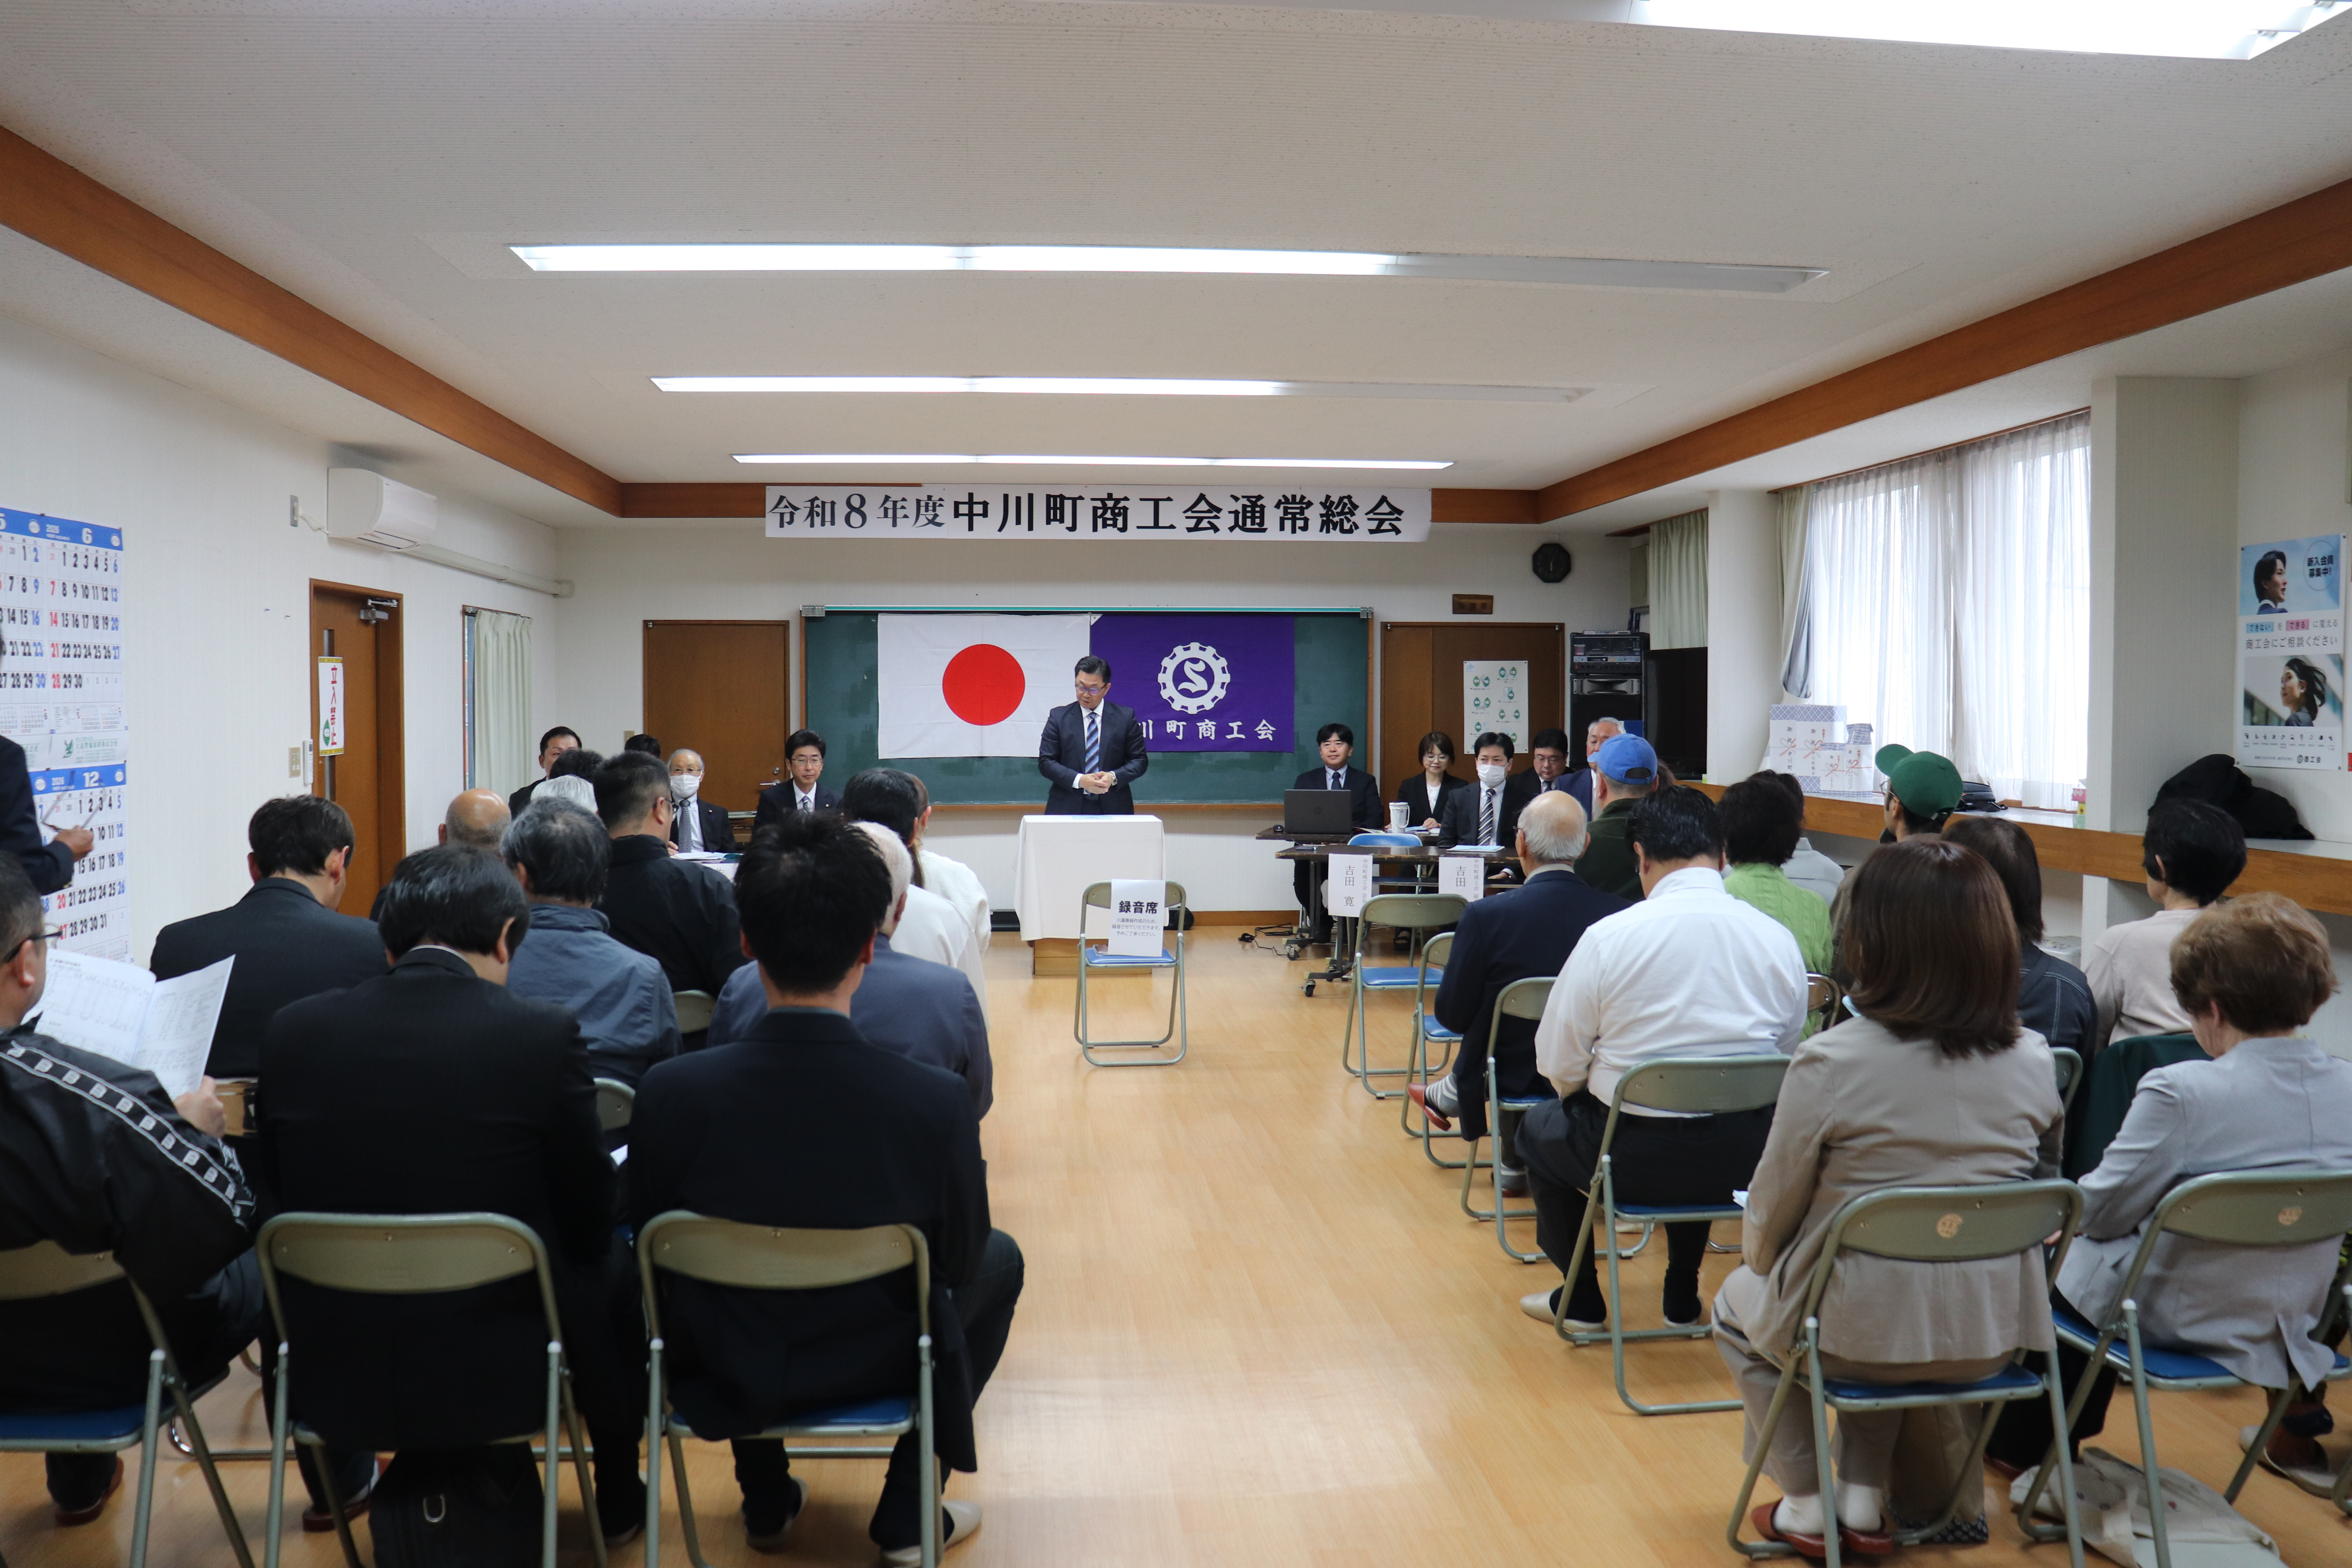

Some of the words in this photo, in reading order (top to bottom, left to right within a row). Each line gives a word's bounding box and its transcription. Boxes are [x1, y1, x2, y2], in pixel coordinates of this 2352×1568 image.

[768, 492, 1405, 536] 令和8年度中川町商工会通常総会
[82, 528, 93, 544] 6
[22, 545, 26, 561] 1
[33, 547, 39, 562] 2
[63, 552, 66, 566] 1
[73, 553, 78, 568] 2
[83, 554, 89, 569] 3
[94, 556, 98, 570] 4
[104, 557, 108, 572] 5
[114, 559, 118, 573] 6
[2307, 555, 2333, 566] 新入会員
[9, 576, 14, 592] 7
[22, 577, 27, 593] 8
[34, 578, 39, 594] 9
[51, 581, 55, 595] 7
[62, 582, 67, 597] 8
[73, 583, 77, 597] 9
[81, 584, 89, 599] 10
[92, 586, 98, 600] 11
[102, 587, 108, 601] 12
[7, 608, 16, 624] 14
[20, 609, 28, 625] 15
[32, 610, 40, 626] 16
[50, 612, 58, 627] 14
[62, 612, 69, 628] 15
[72, 613, 79, 628] 16
[82, 614, 89, 629] 17
[93, 615, 99, 630] 18
[102, 616, 109, 630] 19
[111, 616, 118, 631] 20
[9, 641, 18, 656] 21
[21, 641, 31, 657] 22
[33, 641, 44, 657] 23
[51, 642, 59, 658] 21
[62, 643, 71, 658] 22
[73, 644, 82, 659] 23
[83, 644, 92, 659] 24
[93, 644, 101, 659] 25
[103, 645, 111, 659] 26
[2246, 635, 2337, 650] 商工会にご相談ください
[11, 673, 21, 689] 28
[24, 673, 33, 689] 29
[36, 673, 46, 689] 30
[52, 673, 61, 689] 28
[63, 673, 72, 689] 29
[74, 673, 82, 689] 30
[83, 771, 100, 788] 12
[39, 804, 43, 820] 7
[79, 799, 82, 814] 1
[89, 798, 93, 813] 2
[99, 797, 103, 811] 3
[108, 796, 113, 809] 4
[118, 795, 121, 809] 5
[98, 826, 105, 841] 10
[108, 824, 114, 839] 11
[117, 823, 123, 837] 12
[78, 859, 85, 875] 15
[89, 857, 96, 872] 16
[99, 855, 105, 870] 17
[108, 853, 115, 868] 18
[117, 851, 124, 866] 19
[1345, 865, 1355, 887] 吉田
[1455, 865, 1466, 887] 吉田
[57, 893, 66, 909] 20
[69, 892, 76, 907] 21
[78, 889, 87, 904] 22
[89, 887, 96, 902] 23
[98, 884, 106, 900] 24
[108, 882, 116, 898] 25
[117, 880, 125, 895] 26
[1119, 900, 1158, 914] 録音席
[70, 921, 78, 937] 28
[80, 918, 87, 935] 29
[89, 916, 98, 932] 30
[100, 913, 107, 929] 31
